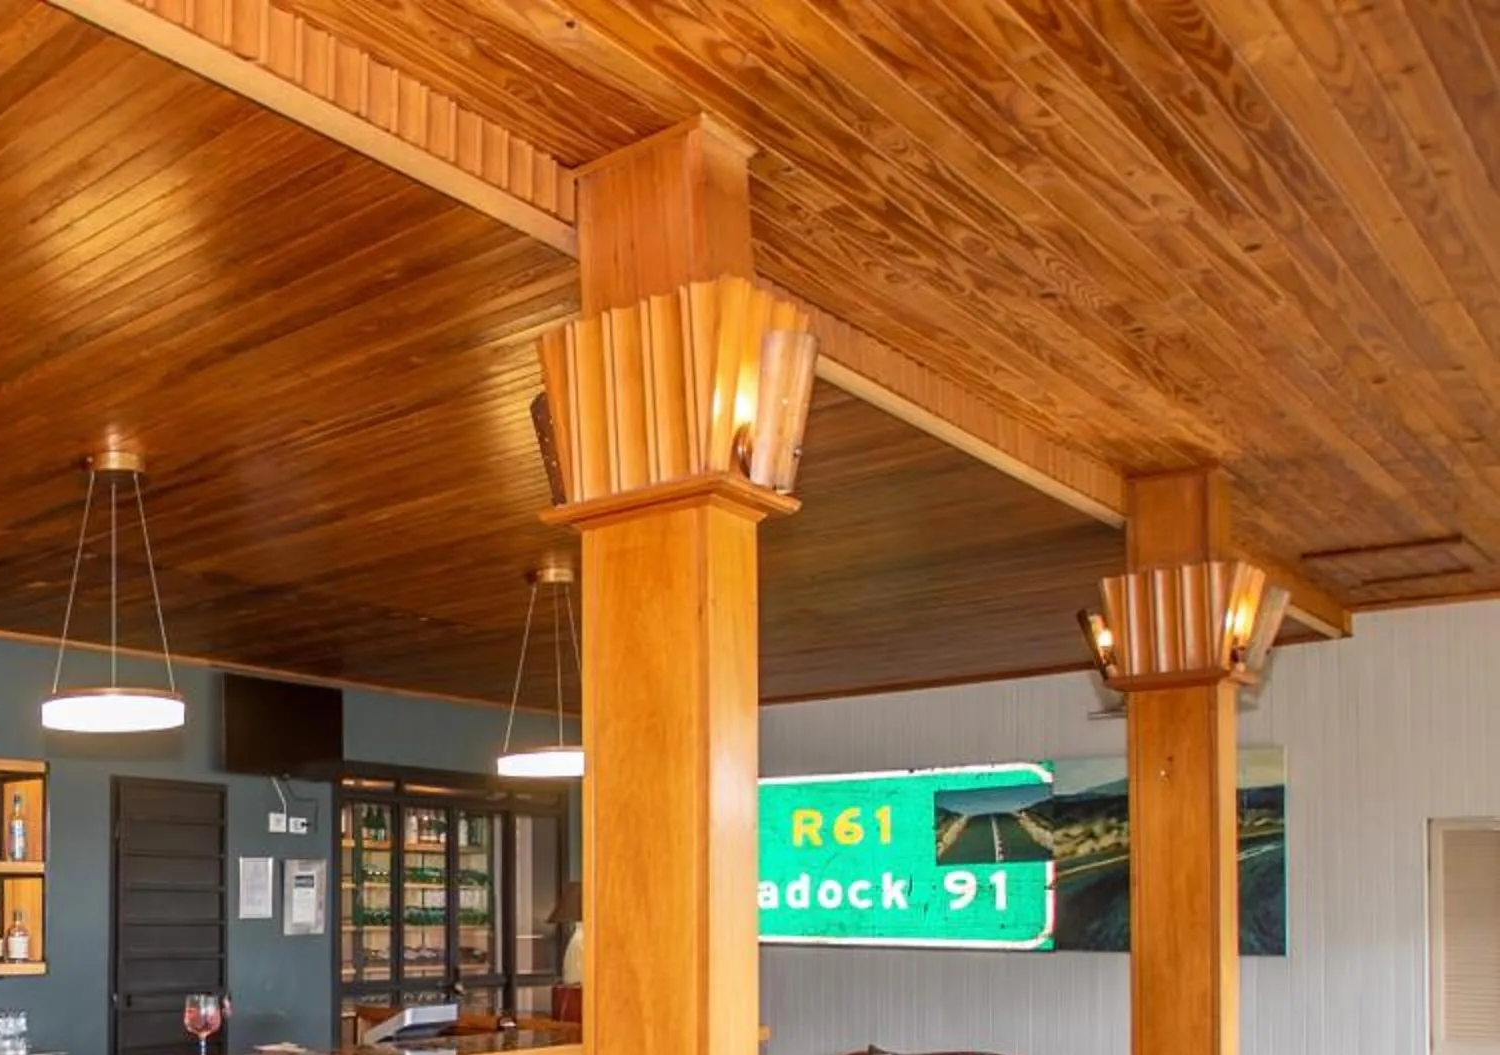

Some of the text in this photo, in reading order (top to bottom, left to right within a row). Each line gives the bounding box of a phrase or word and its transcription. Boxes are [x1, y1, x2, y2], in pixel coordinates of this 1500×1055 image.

[792, 805, 892, 847] R61
[757, 869, 1007, 911] adock 91
